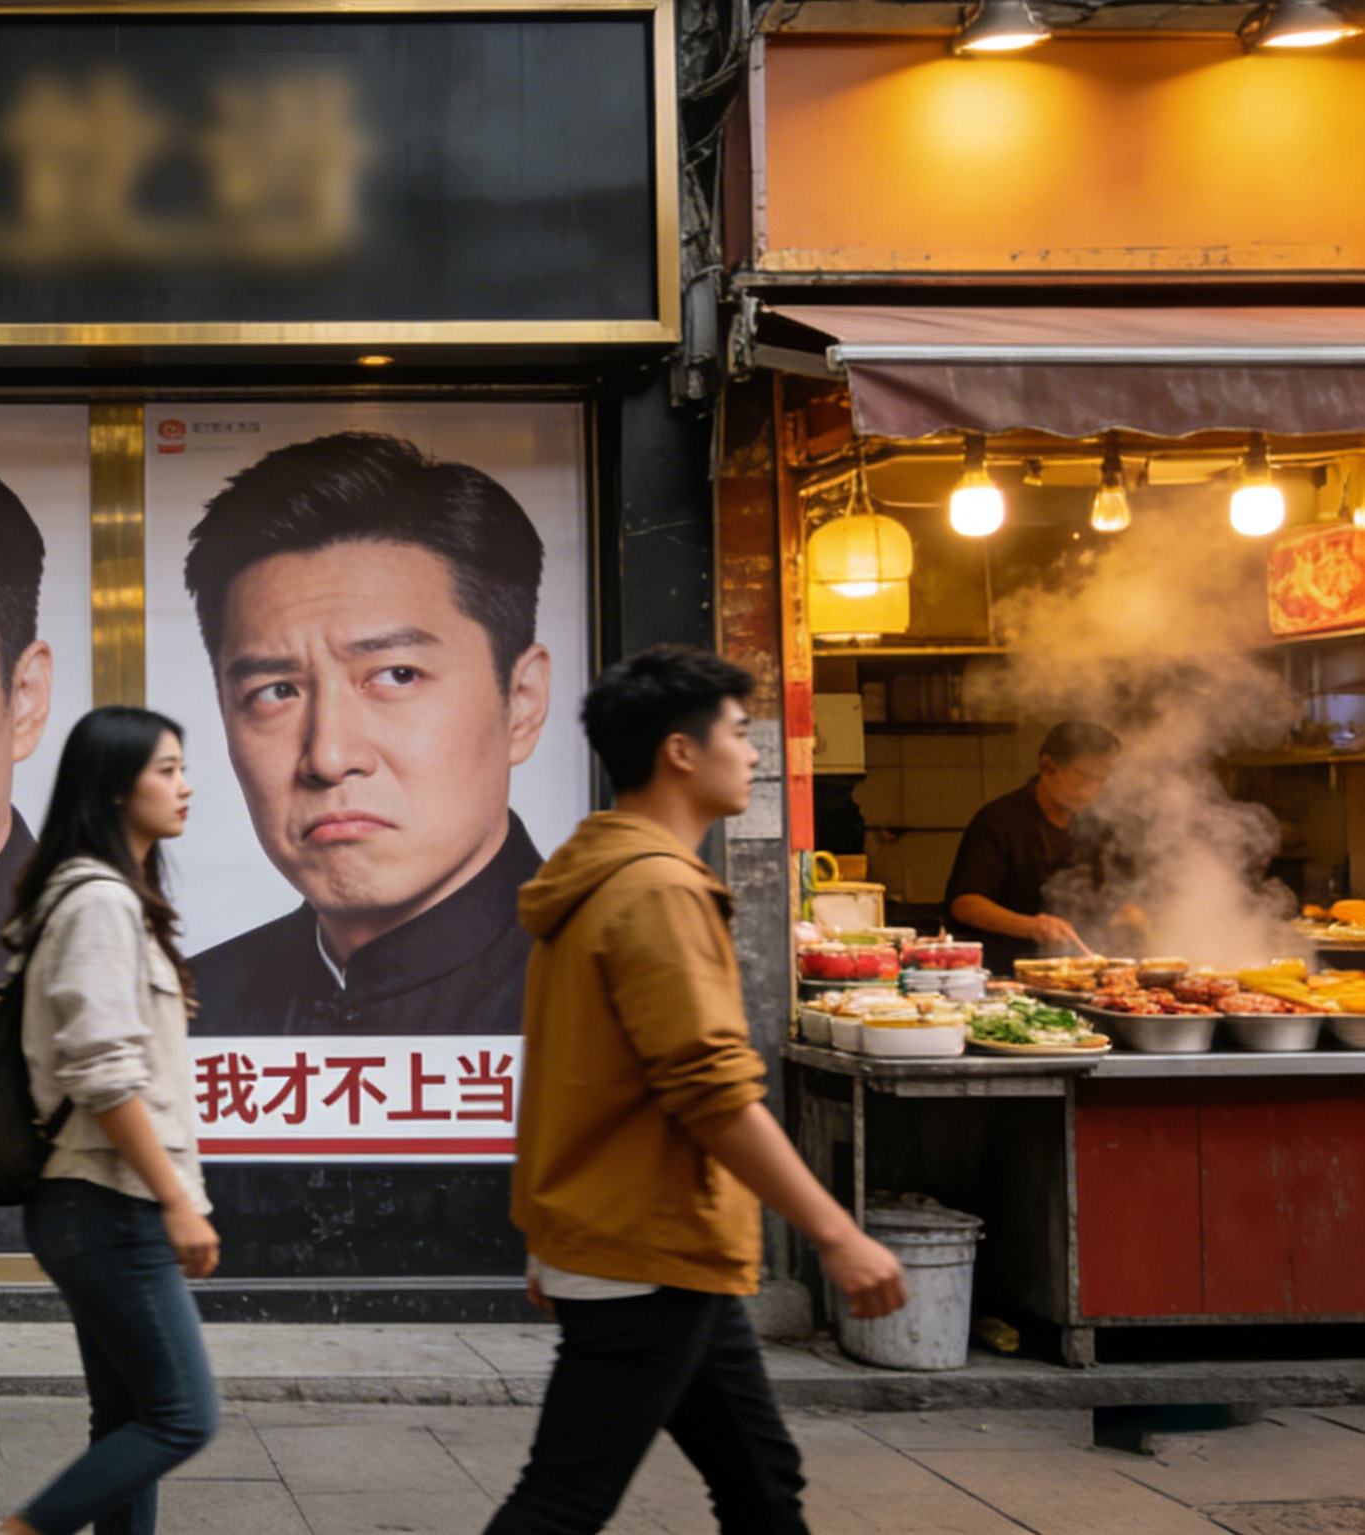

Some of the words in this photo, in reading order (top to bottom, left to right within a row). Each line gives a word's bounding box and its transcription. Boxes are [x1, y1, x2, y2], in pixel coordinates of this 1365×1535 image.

[195, 1051, 514, 1125] 我才不上当
